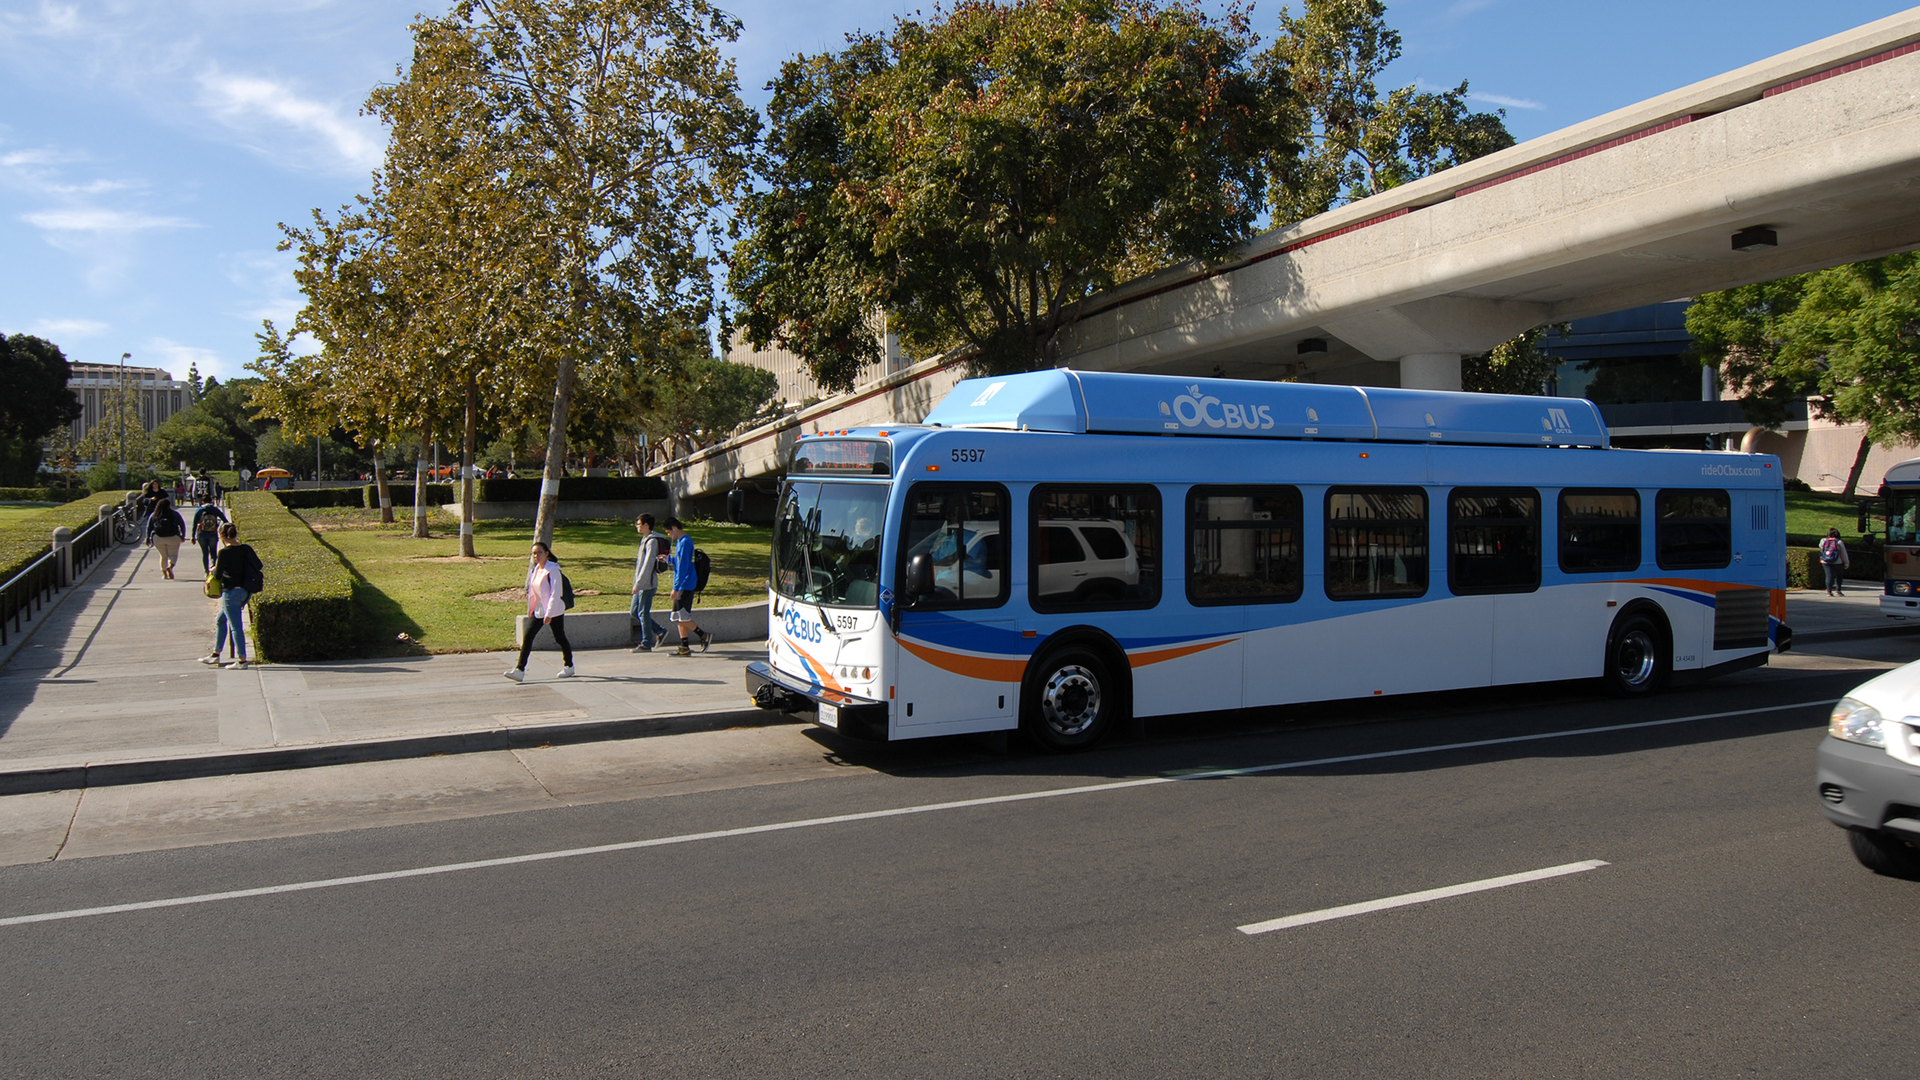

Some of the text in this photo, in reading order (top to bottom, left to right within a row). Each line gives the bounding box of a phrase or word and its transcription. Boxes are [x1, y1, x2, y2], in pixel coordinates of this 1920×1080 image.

[951, 449, 985, 462] 5597
[1701, 464, 1761, 476] rideOCbus.com
[836, 616, 858, 630] 5597
